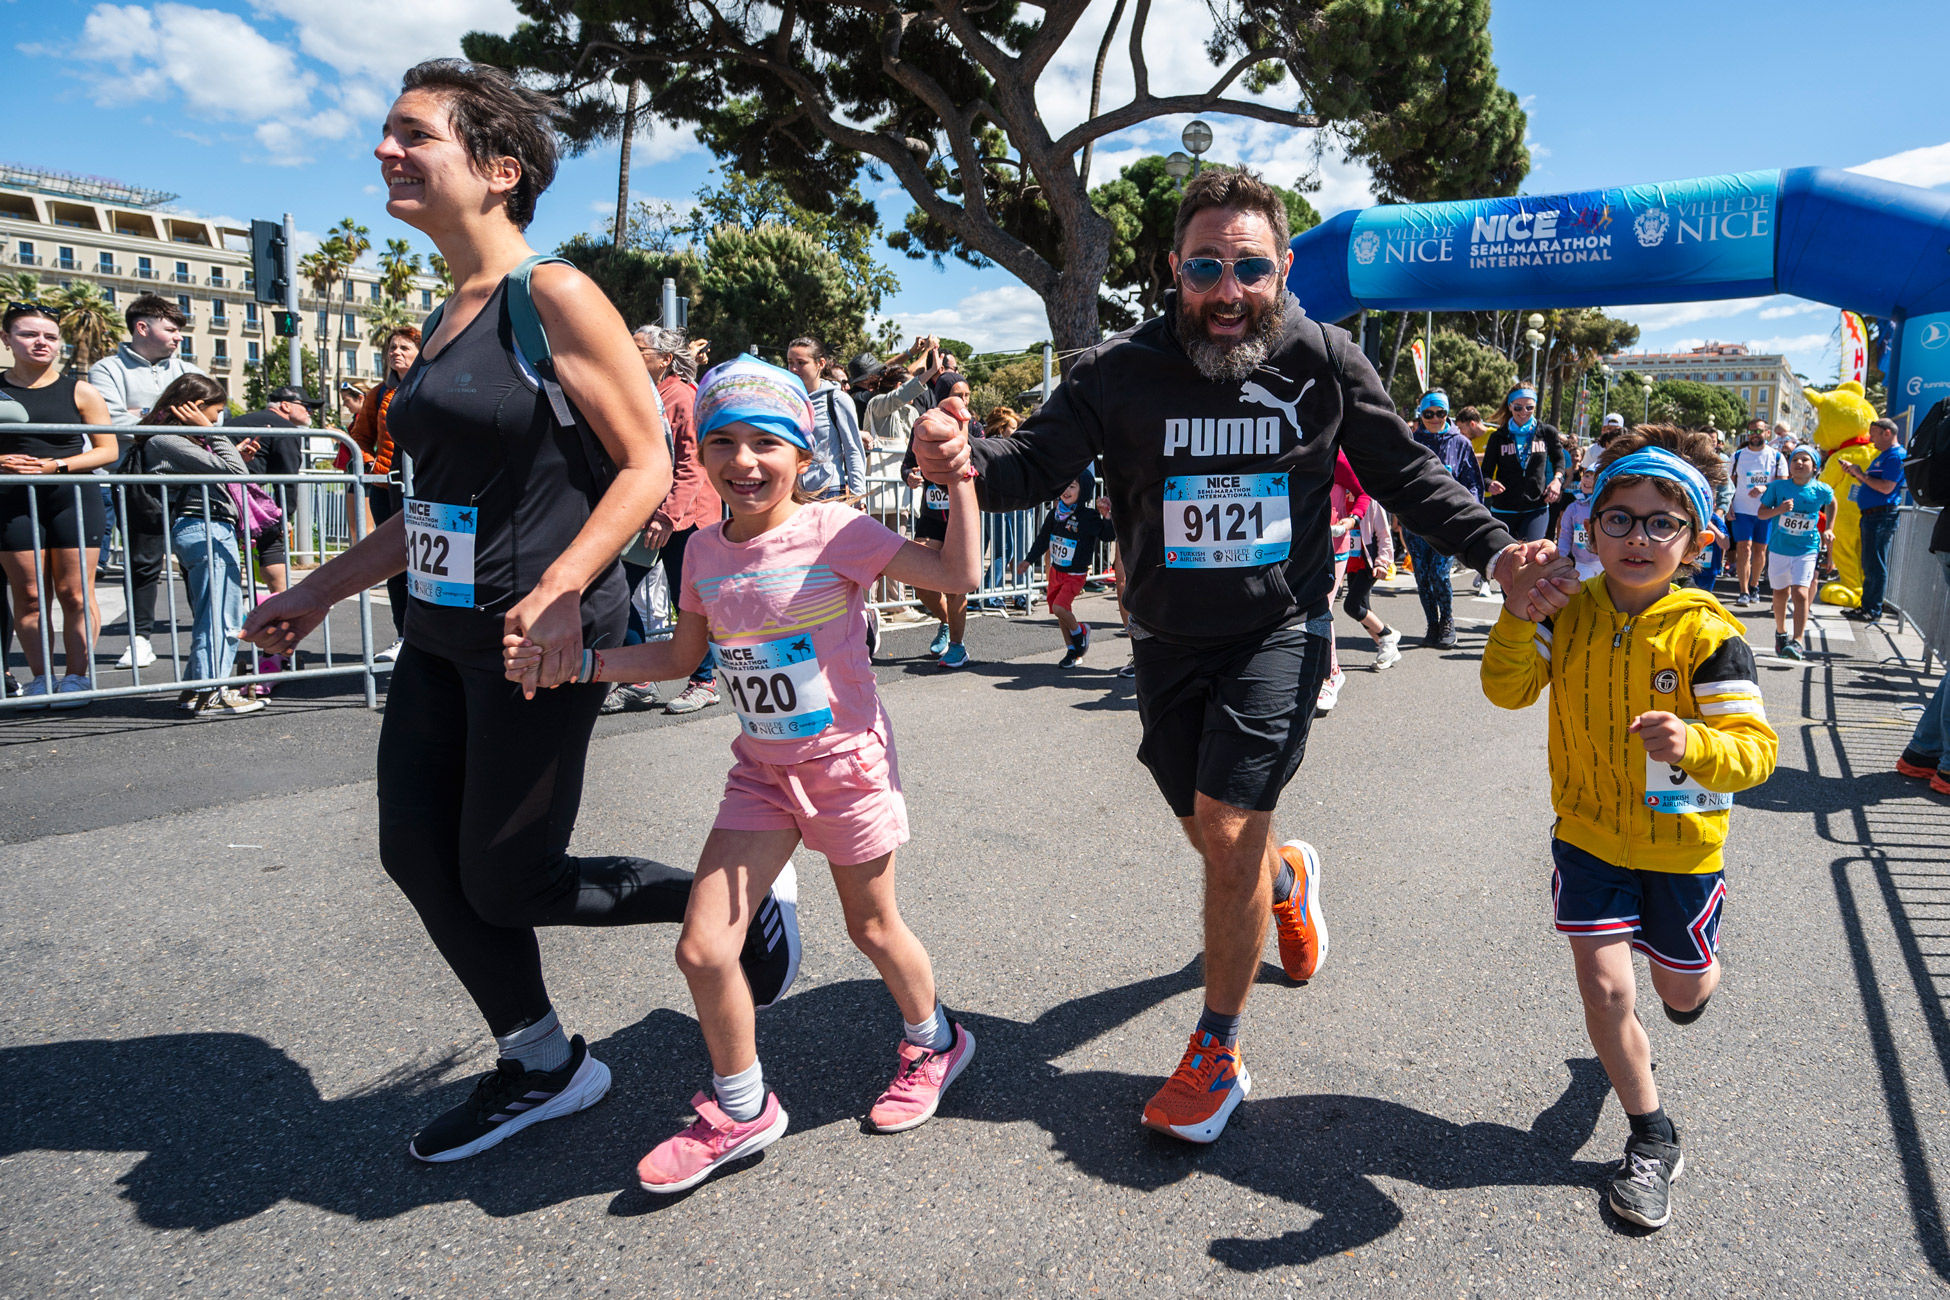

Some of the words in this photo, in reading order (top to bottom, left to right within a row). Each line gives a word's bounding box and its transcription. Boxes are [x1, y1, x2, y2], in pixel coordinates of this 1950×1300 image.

[1677, 199, 1733, 217] VILLE
[1740, 194, 1770, 211] DE
[1387, 227, 1428, 241] VILLE
[1431, 225, 1456, 239] DE
[1470, 210, 1561, 243] NICE
[1675, 210, 1769, 245] NICE
[1384, 239, 1454, 264] NICE
[1470, 234, 1612, 257] SEMI-MARATHON
[1470, 250, 1612, 269] INTERNATIONAL
[1163, 416, 1281, 457] PUMA
[1206, 476, 1241, 489] NICE
[1750, 476, 1768, 484] 8602
[1197, 487, 1251, 495] SEMI-MARATHON
[409, 502, 431, 516] NICE
[1183, 502, 1264, 542] 9121
[1784, 517, 1810, 530] 8614
[1225, 554, 1250, 562] NICE
[720, 648, 754, 661] NICE
[719, 670, 797, 713] 120
[760, 727, 786, 735] NICE
[1708, 798, 1730, 806] NICE
